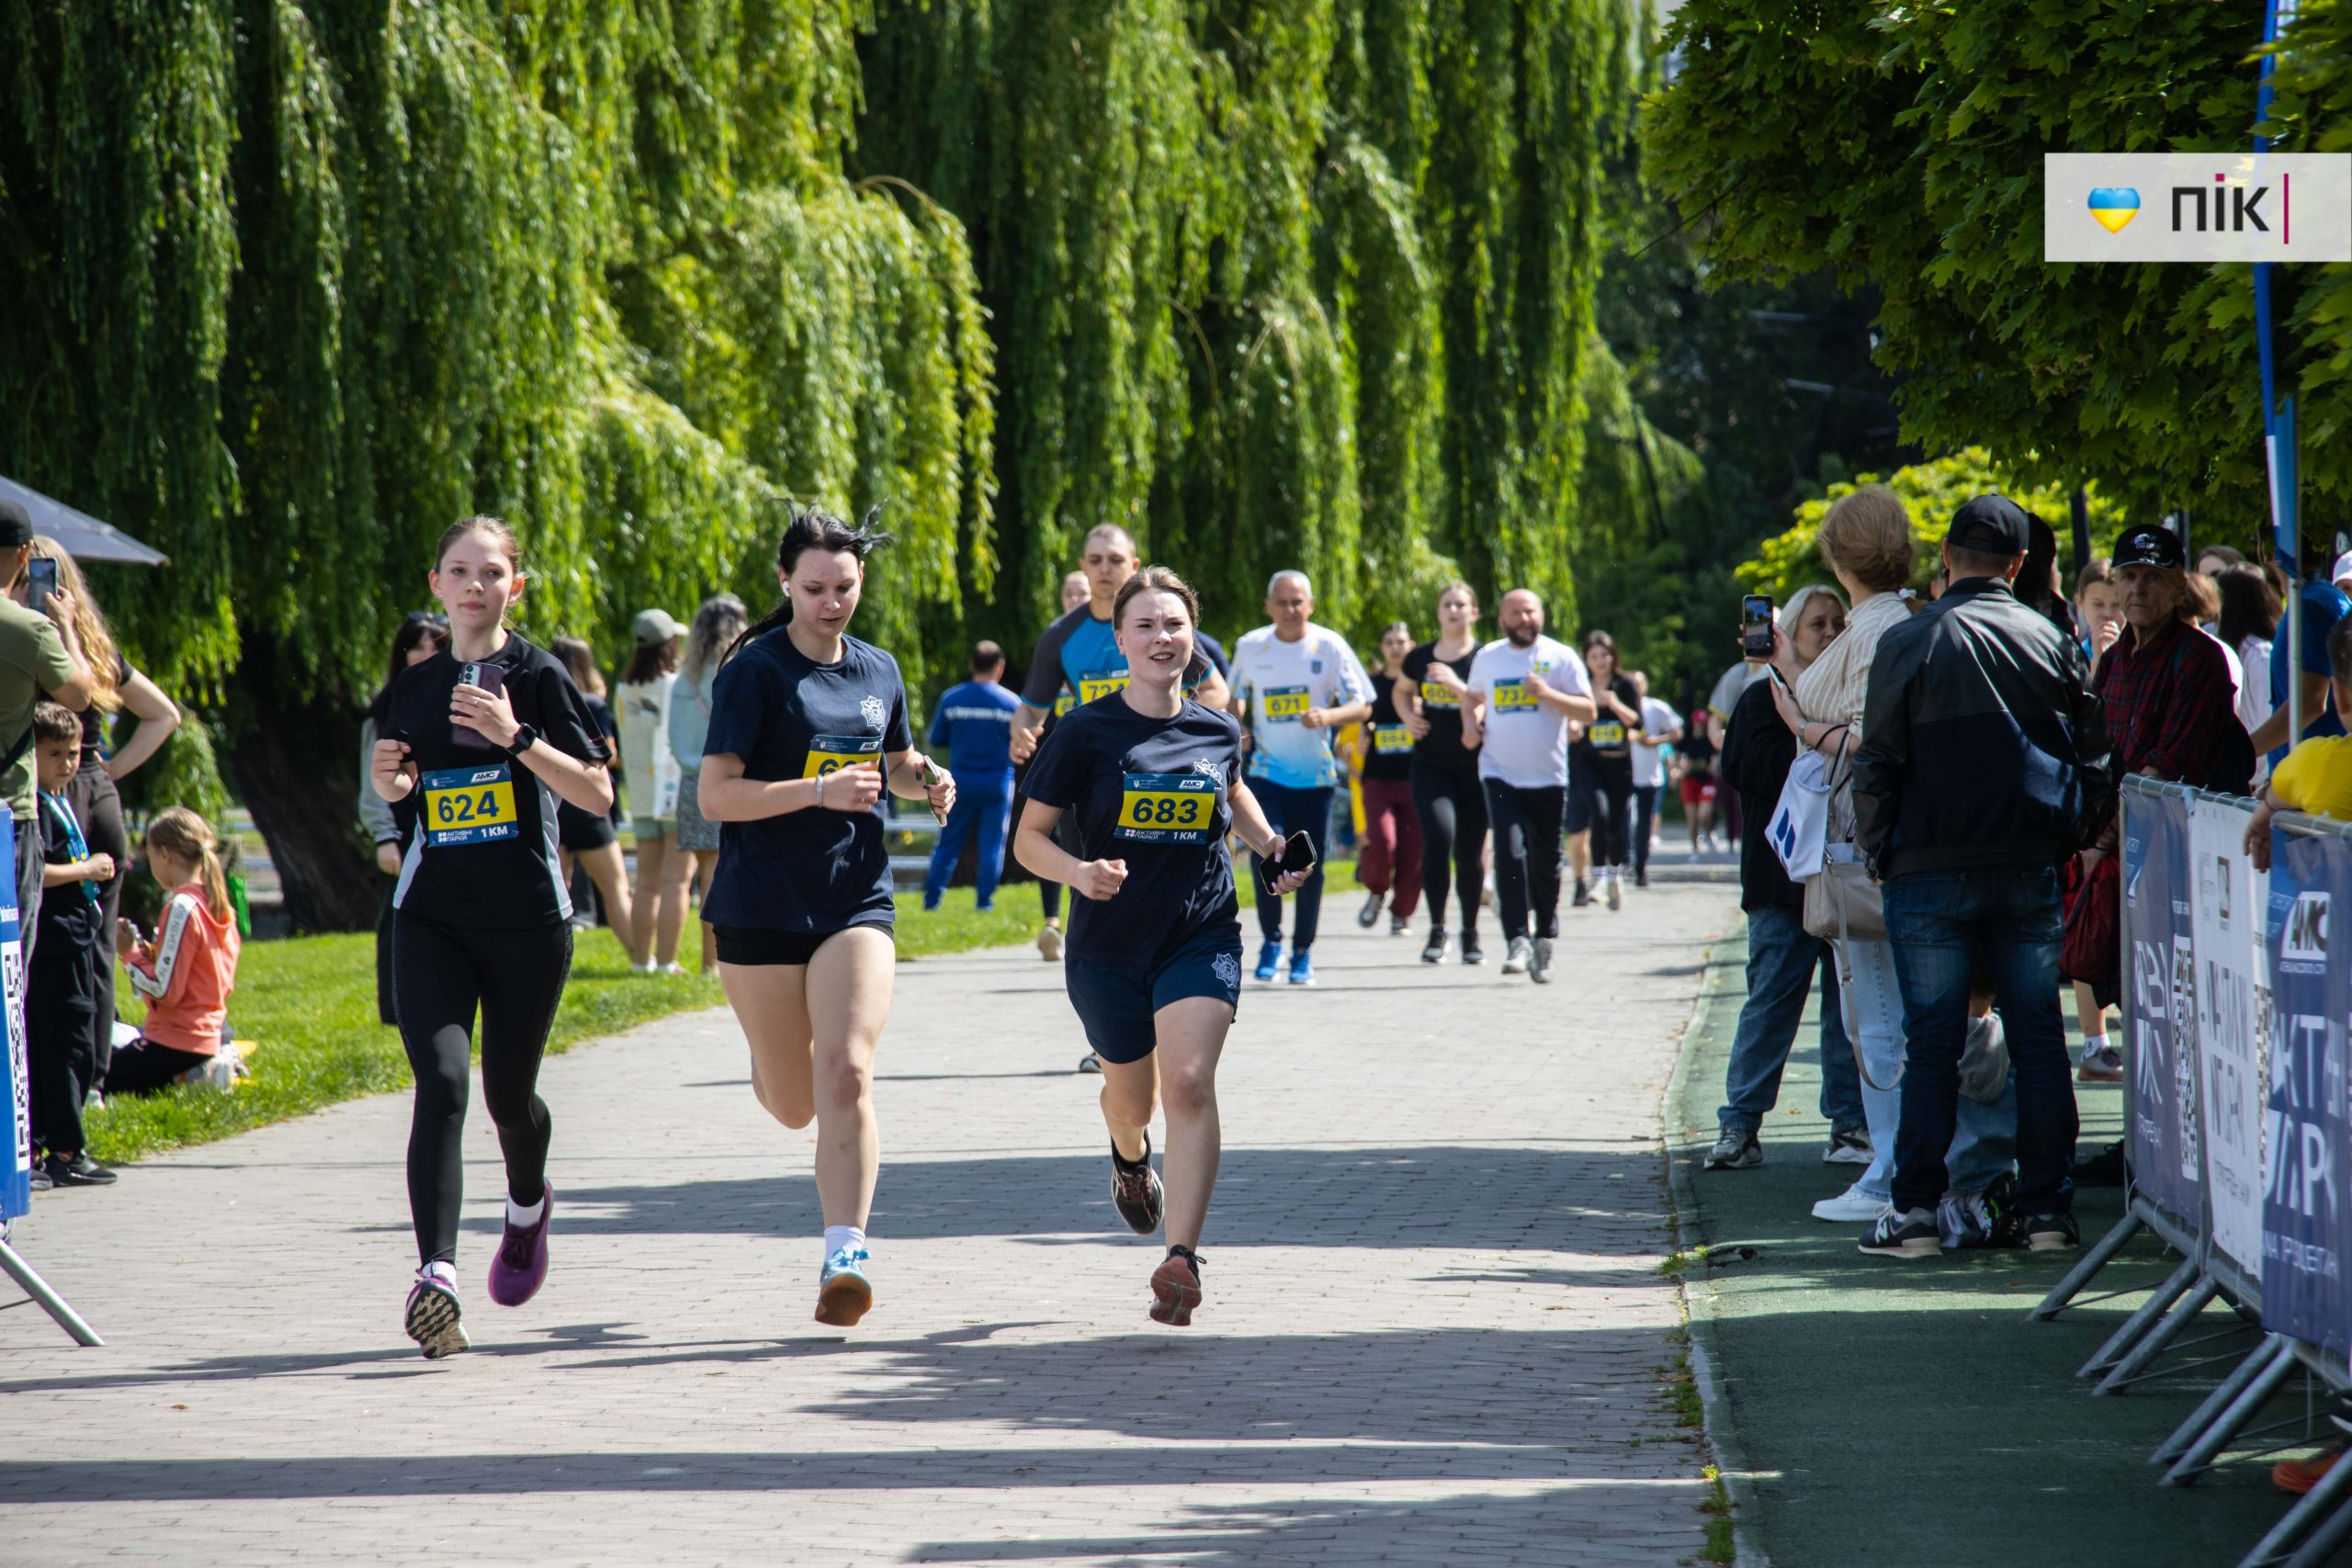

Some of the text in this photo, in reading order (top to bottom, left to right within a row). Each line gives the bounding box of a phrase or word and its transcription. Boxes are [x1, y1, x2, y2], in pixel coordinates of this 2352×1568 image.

[1272, 698, 1300, 712] 671
[438, 791, 500, 823] 624
[1133, 797, 1198, 824] 683
